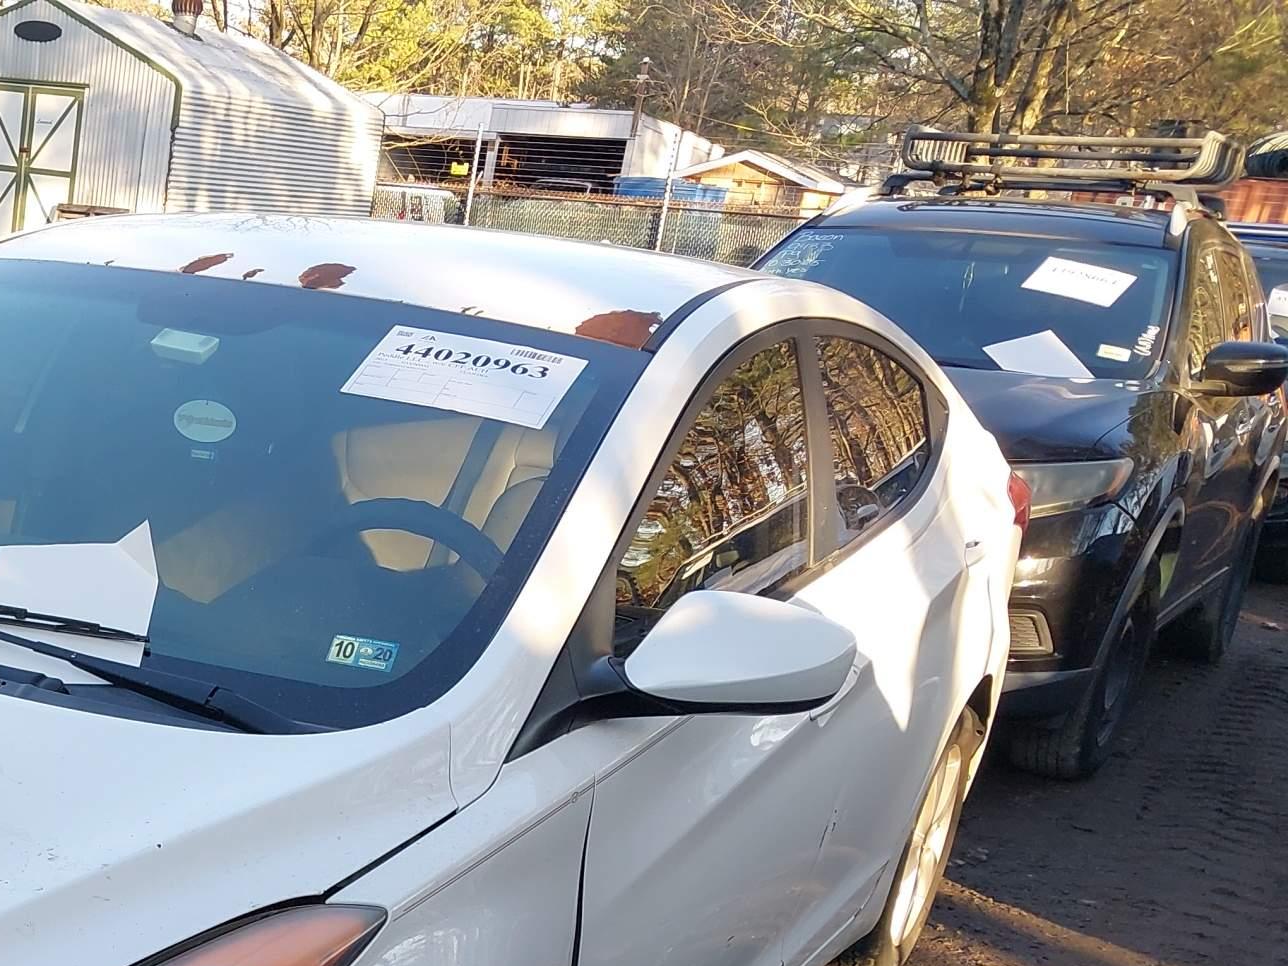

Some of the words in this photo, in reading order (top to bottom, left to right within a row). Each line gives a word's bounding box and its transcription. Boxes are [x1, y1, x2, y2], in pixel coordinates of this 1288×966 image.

[395, 343, 550, 379] 44020963
[335, 640, 356, 659] 10
[373, 647, 393, 661] 20
